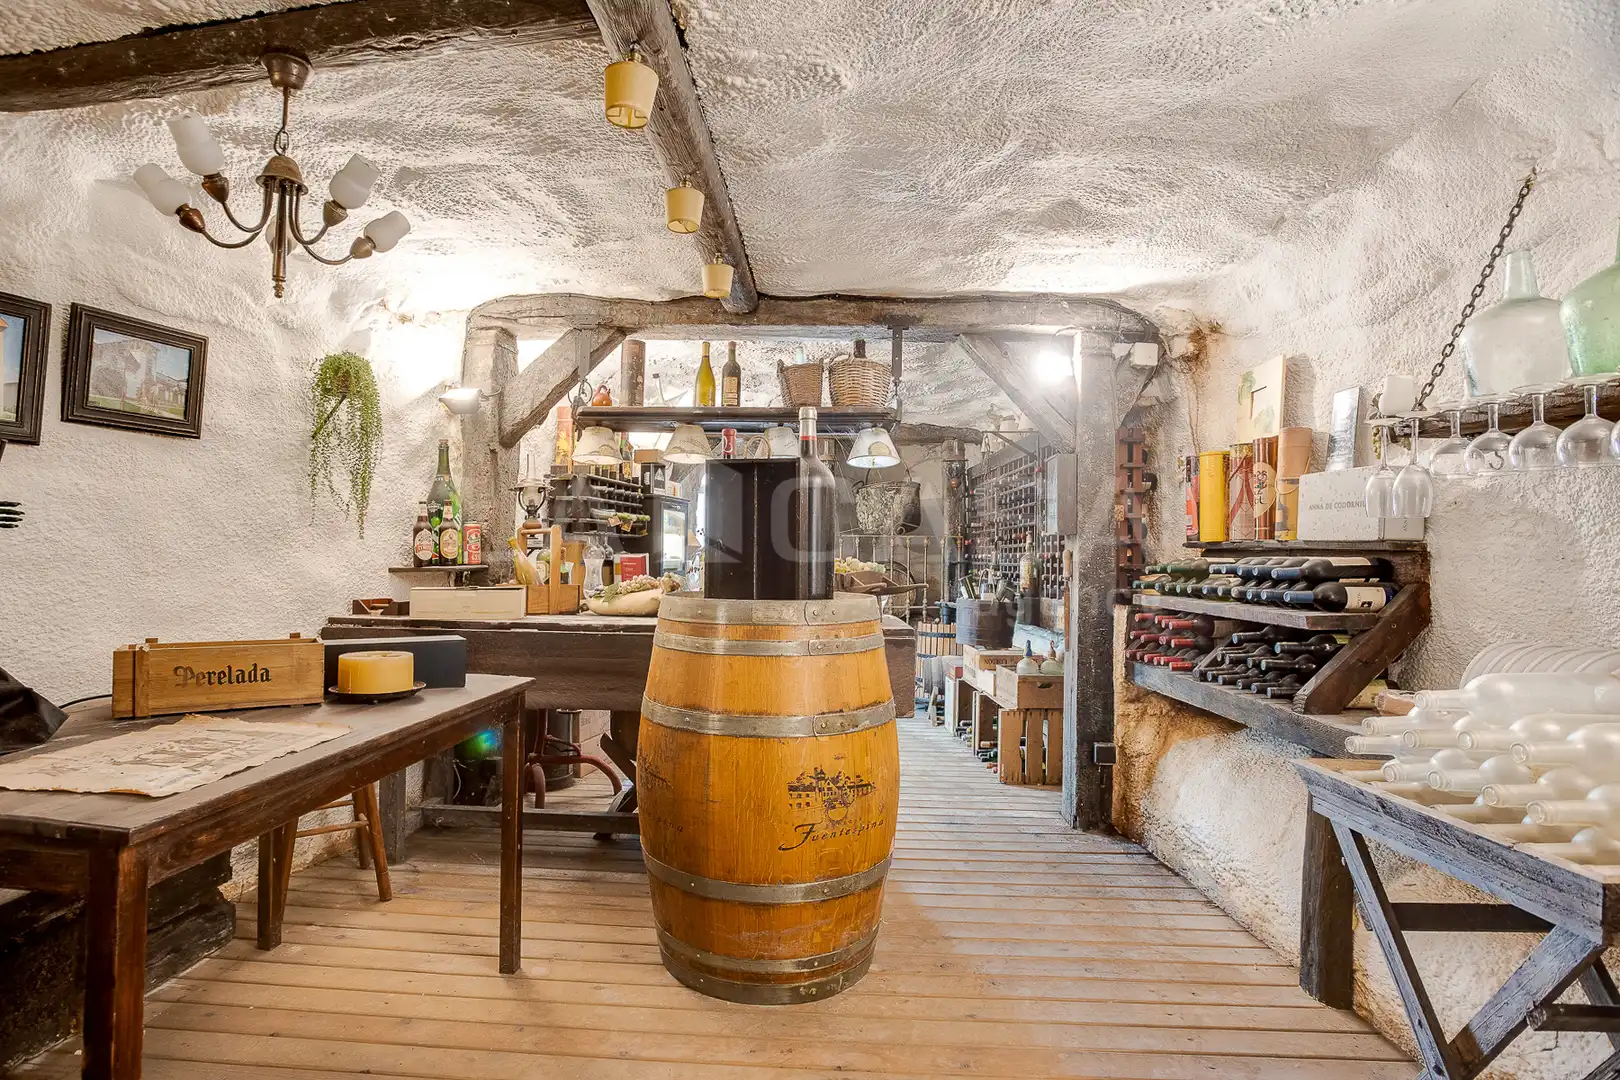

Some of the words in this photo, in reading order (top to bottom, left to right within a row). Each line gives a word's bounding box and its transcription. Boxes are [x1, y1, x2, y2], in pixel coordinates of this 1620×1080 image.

[1308, 503, 1324, 511] ANNA
[1325, 502, 1333, 510] DE
[173, 663, 271, 689] Perelada
[778, 819, 884, 851] Fuentespina
